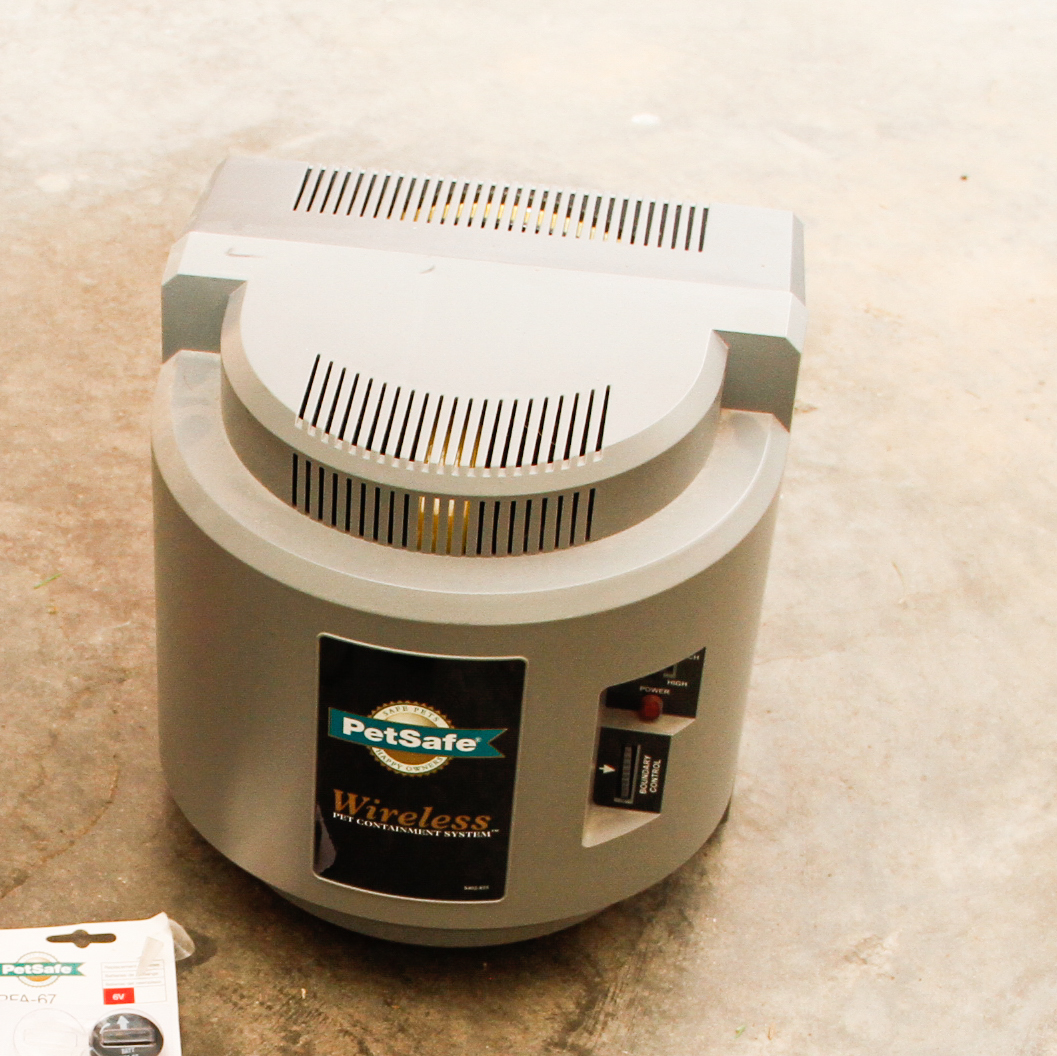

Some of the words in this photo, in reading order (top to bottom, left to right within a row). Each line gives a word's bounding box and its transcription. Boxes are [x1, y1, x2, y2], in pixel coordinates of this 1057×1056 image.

[639, 686, 670, 695] POWER
[383, 705, 408, 716] SAFE
[414, 707, 440, 722] PETS
[375, 749, 403, 769] HAPPY
[405, 757, 443, 772] OWNERS
[639, 754, 652, 794] BOUNDARY
[649, 759, 661, 793] CONTROL
[333, 788, 492, 831] Wireless
[333, 811, 355, 823] PET
[356, 814, 442, 837] CONTAINMENT
[112, 993, 125, 1001] 6V
